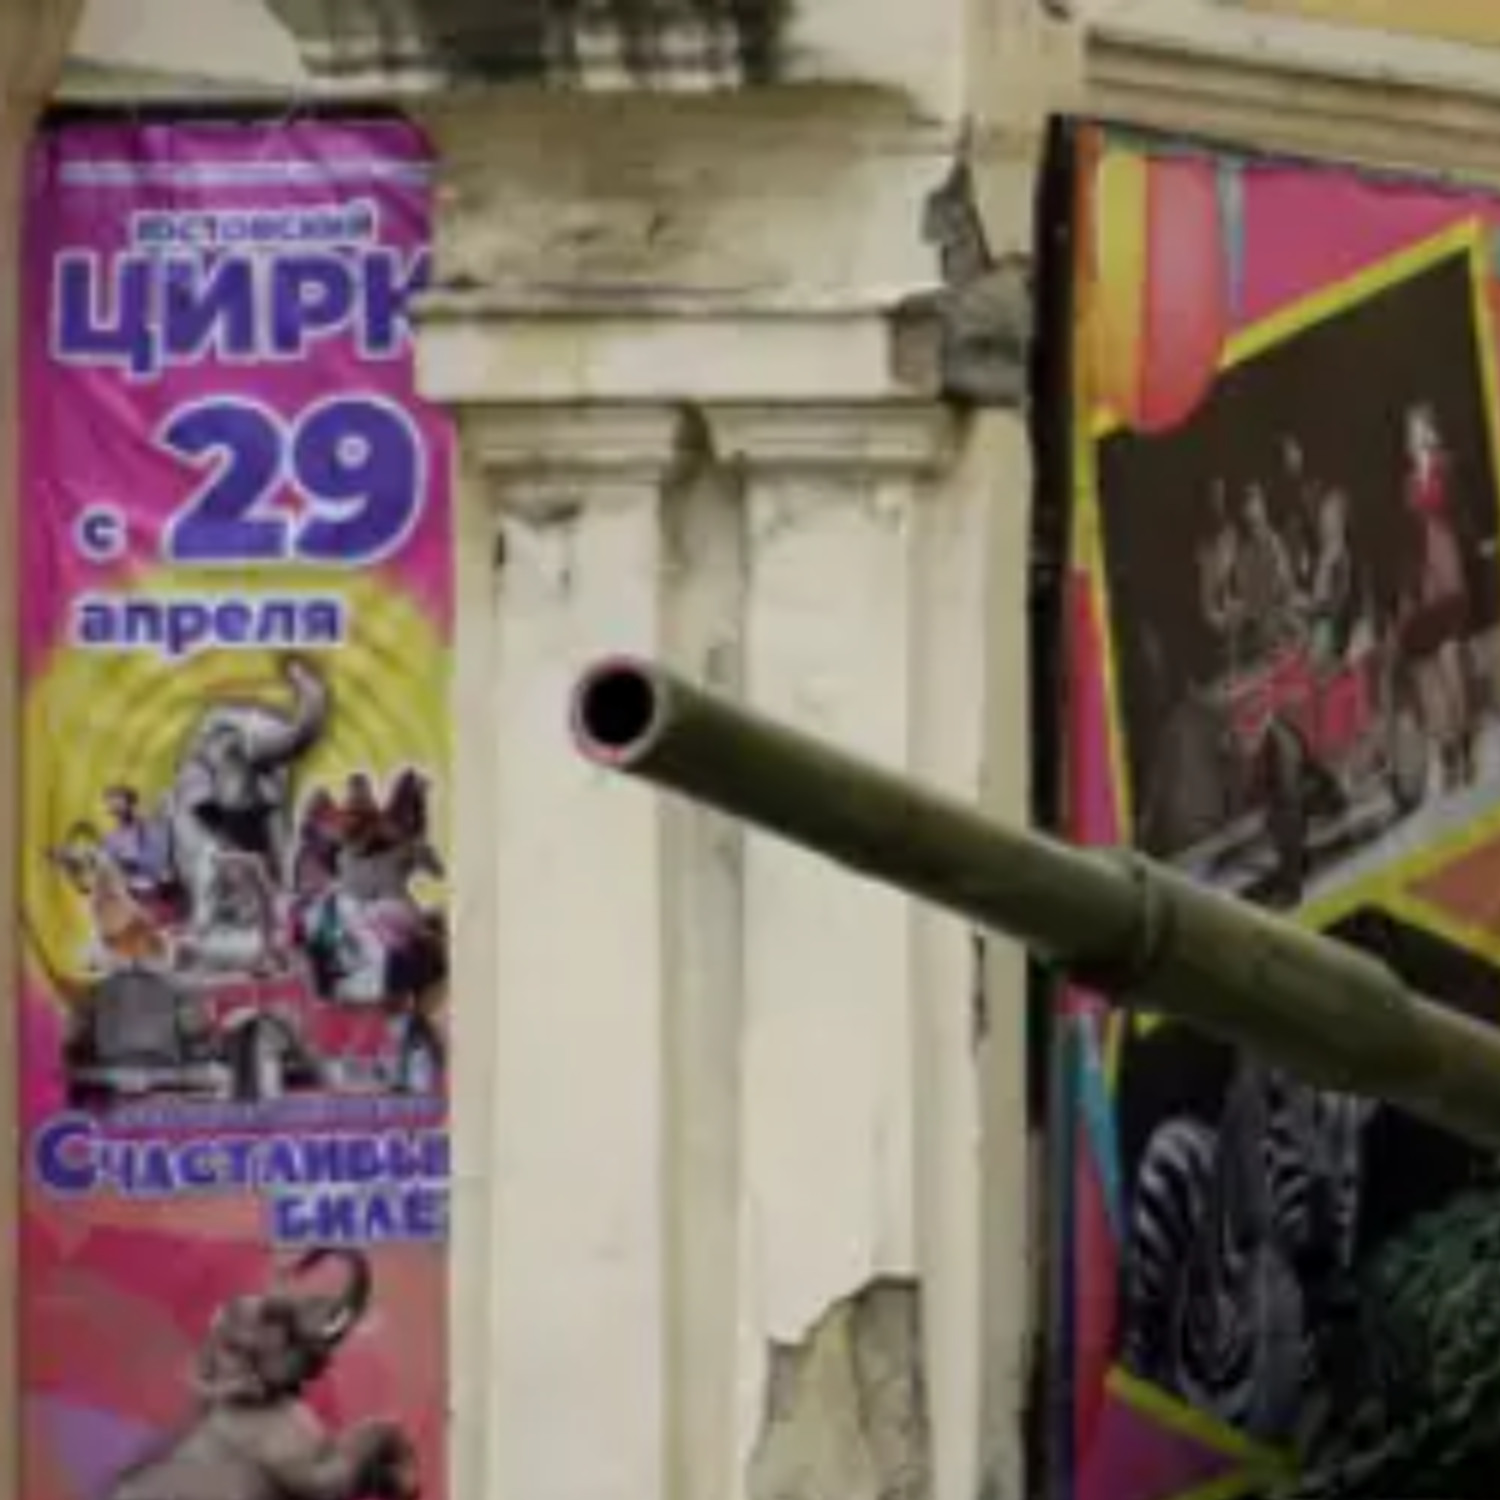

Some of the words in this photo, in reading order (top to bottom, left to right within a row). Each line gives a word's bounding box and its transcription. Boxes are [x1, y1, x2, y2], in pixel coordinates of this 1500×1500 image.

[57, 250, 432, 377] ЦИРК
[160, 396, 424, 564] 29
[78, 597, 343, 657] апреля
